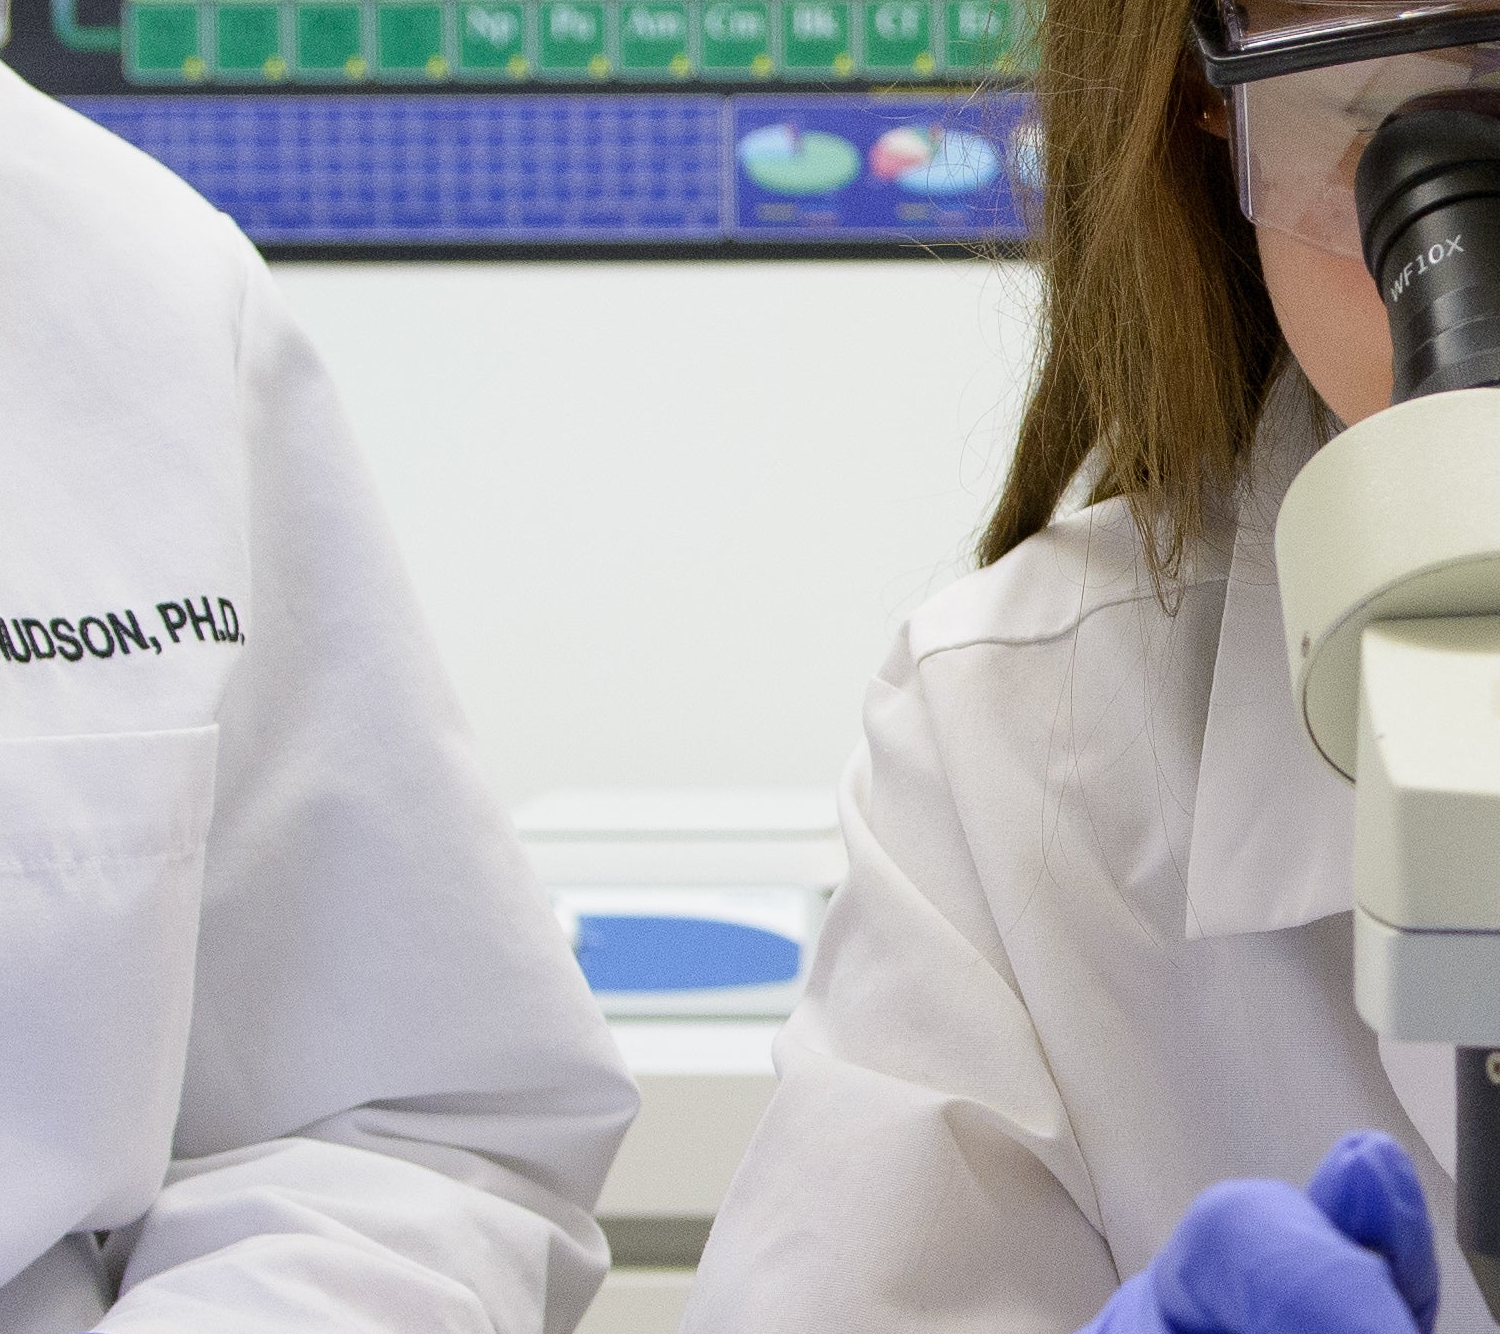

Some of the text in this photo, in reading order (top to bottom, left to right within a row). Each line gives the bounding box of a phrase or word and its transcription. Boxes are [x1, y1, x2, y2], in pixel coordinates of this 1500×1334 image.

[467, 8, 517, 44] Np
[628, 8, 683, 37] Am
[706, 7, 764, 37] Cm
[793, 6, 838, 37] Bk
[874, 5, 919, 37] Cf
[1387, 233, 1466, 304] WF10X
